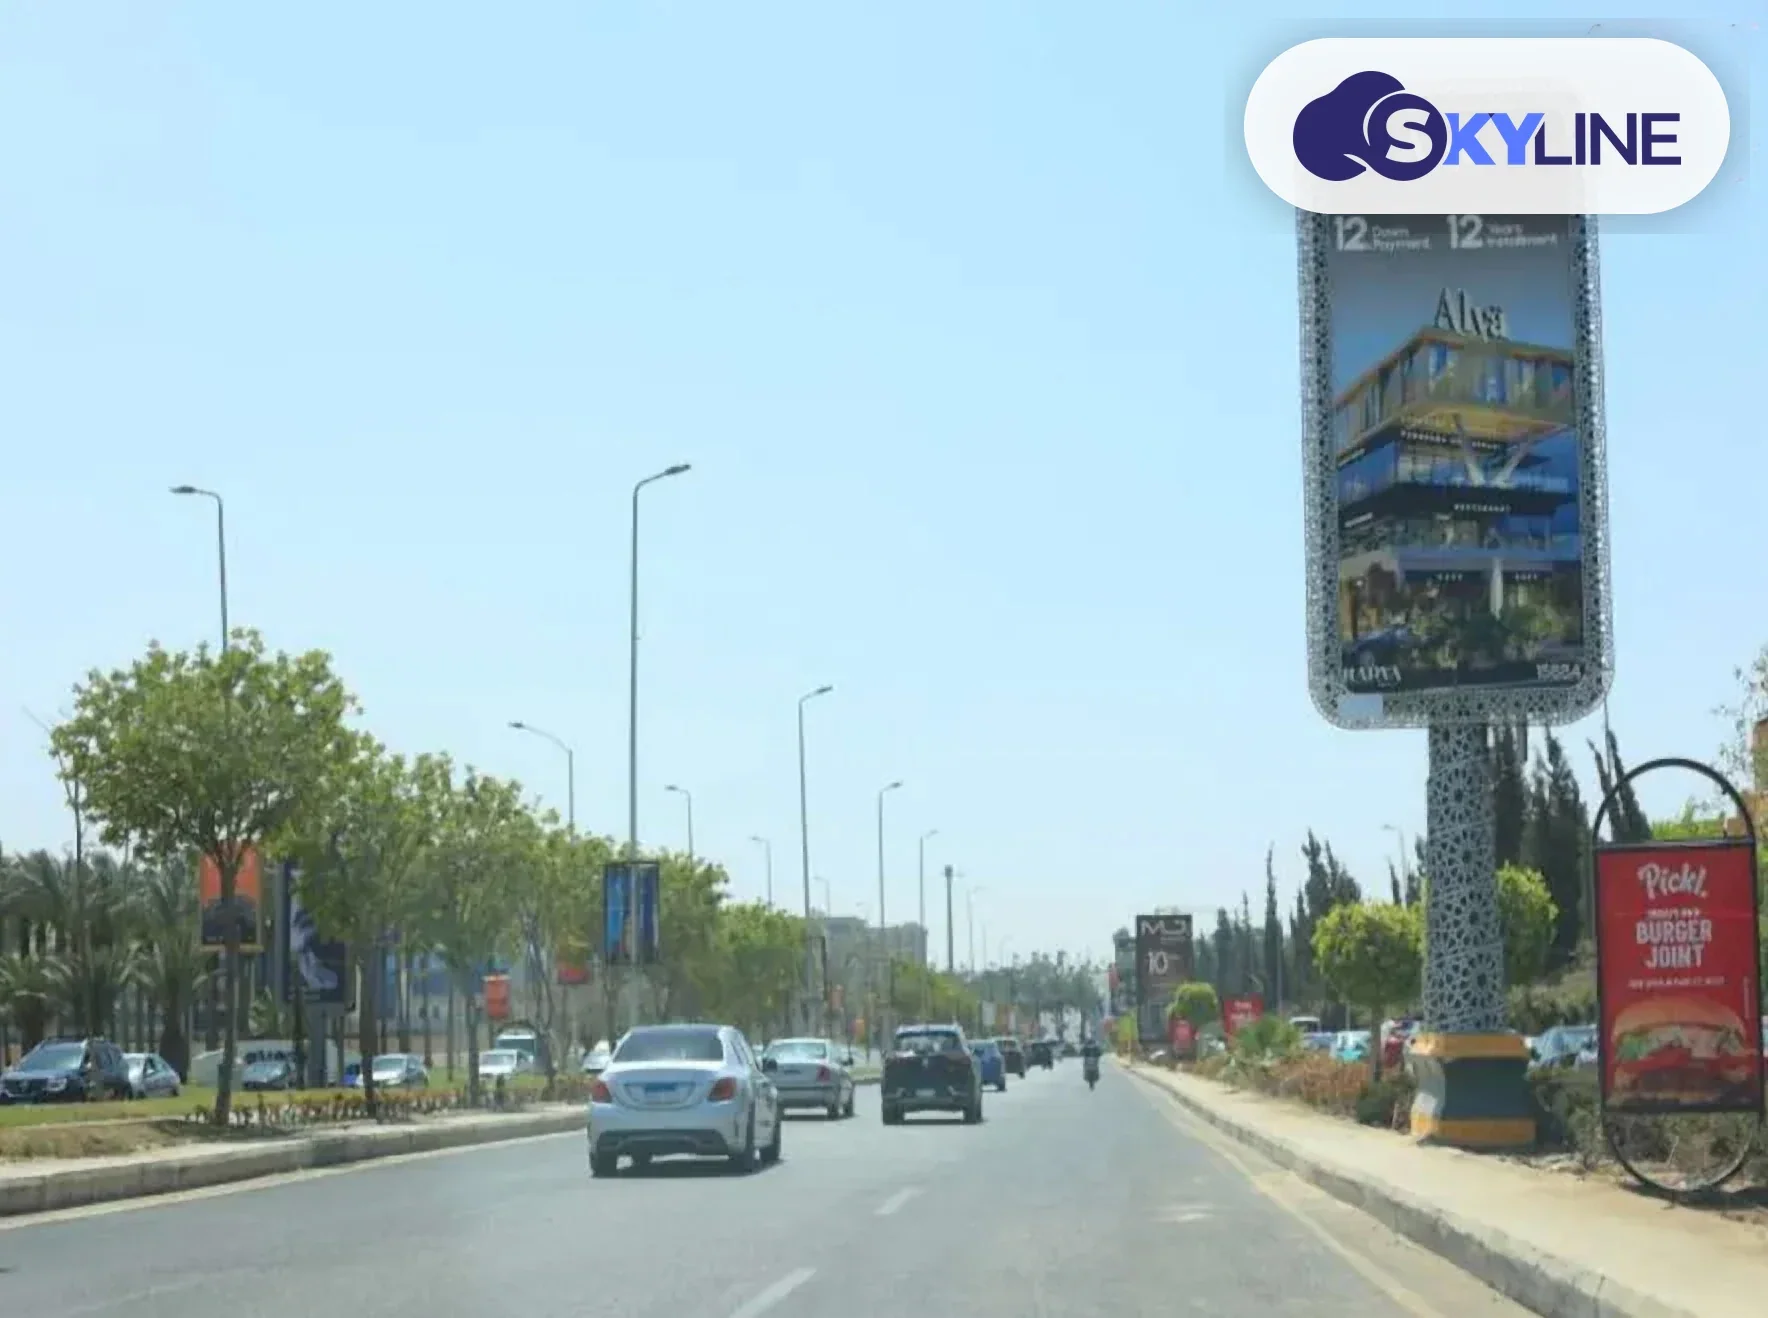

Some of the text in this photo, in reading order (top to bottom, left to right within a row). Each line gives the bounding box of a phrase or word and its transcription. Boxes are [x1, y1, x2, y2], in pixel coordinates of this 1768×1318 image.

[1334, 215, 1369, 251] 12
[1447, 214, 1484, 249] 12
[1636, 919, 1712, 945] BURGER
[1643, 943, 1704, 969] JOINT
